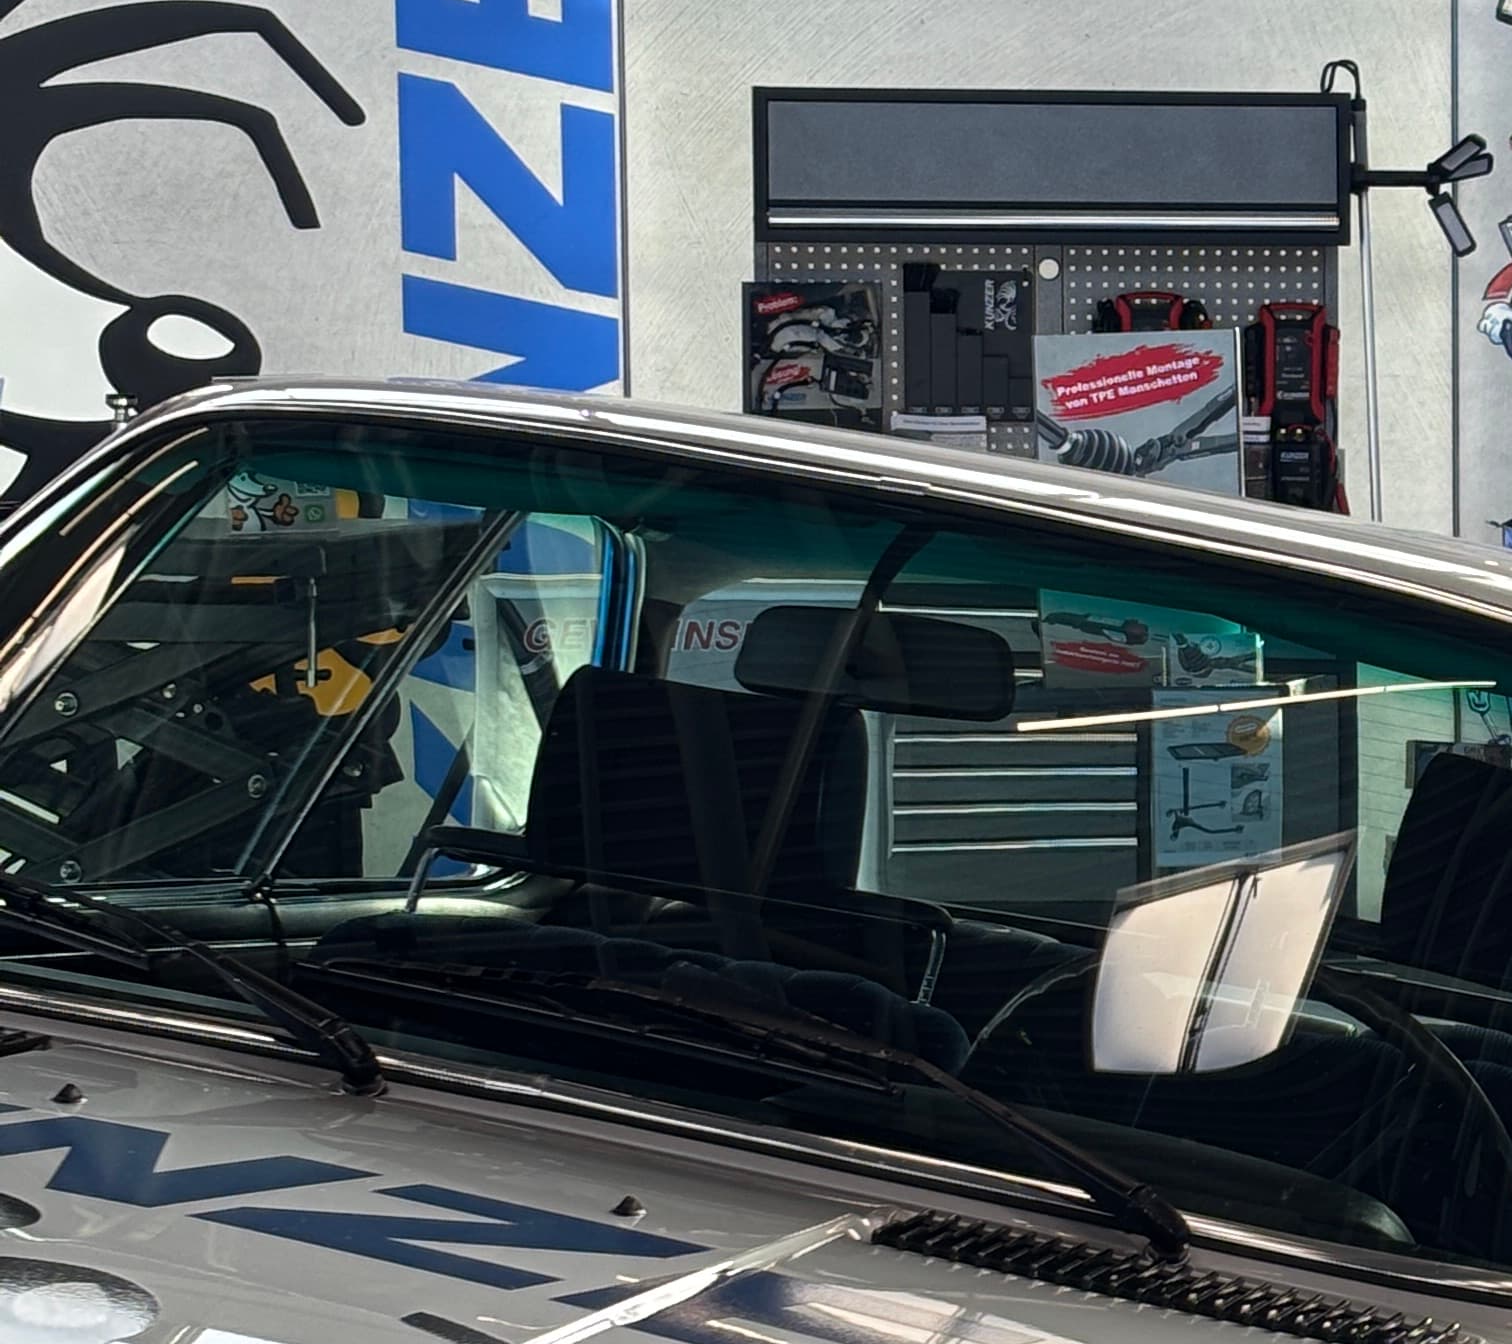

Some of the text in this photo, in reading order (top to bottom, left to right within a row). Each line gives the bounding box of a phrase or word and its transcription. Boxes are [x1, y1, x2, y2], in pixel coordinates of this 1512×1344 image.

[984, 278, 996, 331] KUNZER
[1056, 356, 1200, 397] Professionelle Montage
[1065, 371, 1198, 410] von TPE Manschetten
